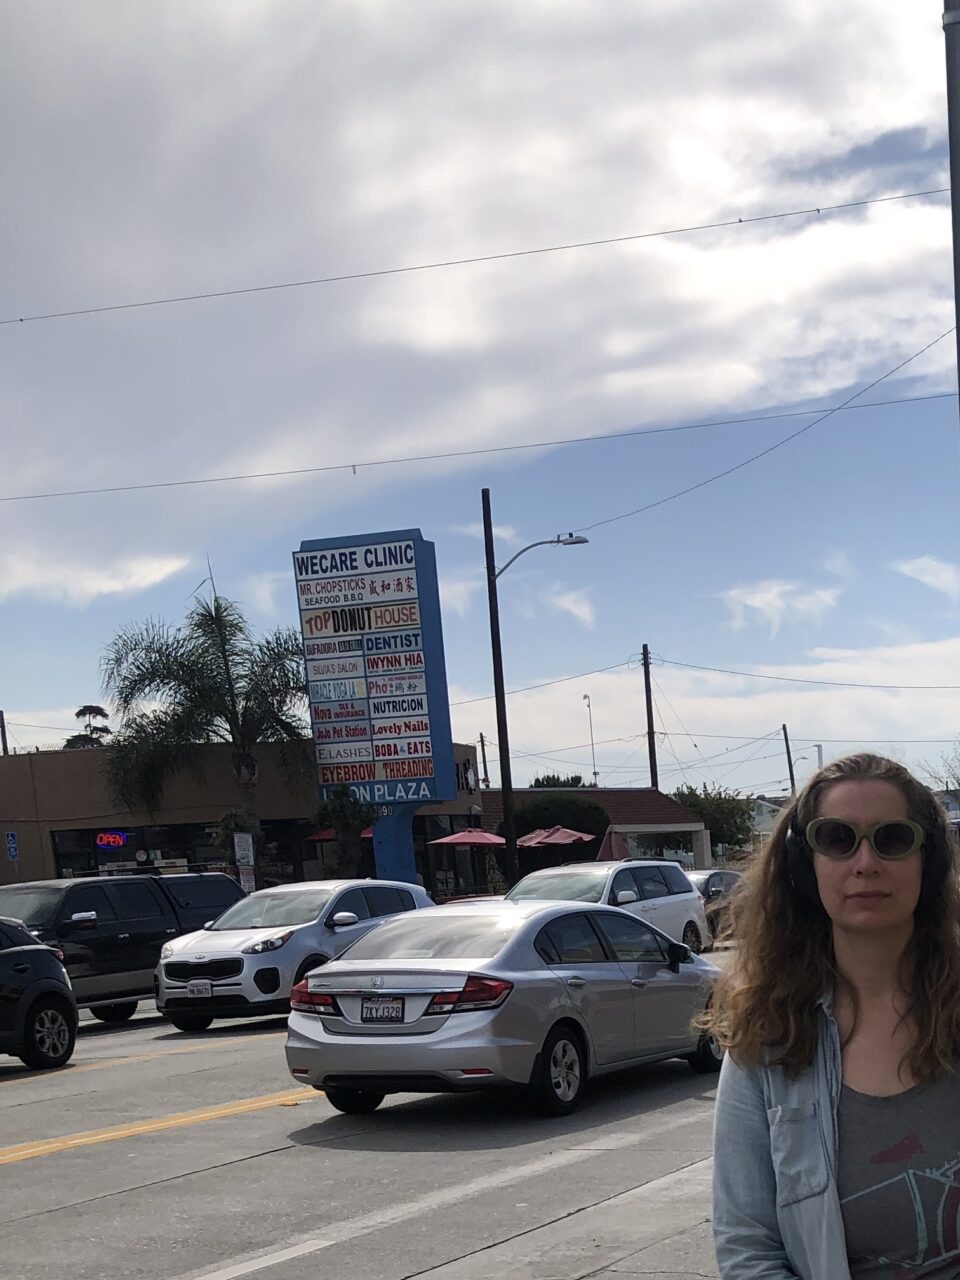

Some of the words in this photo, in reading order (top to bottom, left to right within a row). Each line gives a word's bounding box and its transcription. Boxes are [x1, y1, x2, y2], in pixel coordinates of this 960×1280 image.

[296, 551, 359, 576] WECARE
[364, 544, 414, 568] CLINIC
[305, 595, 341, 606] SEAFOOD
[305, 611, 332, 636] TOP
[332, 607, 373, 633] DONUT
[375, 606, 418, 625] HOUSE
[366, 634, 420, 651] DENTIST
[404, 653, 423, 666] HIA
[337, 662, 358, 673] SALON
[333, 680, 348, 699] YOGA
[314, 705, 332, 720] Nova
[373, 698, 424, 714] NUTRICION
[334, 709, 366, 719] INSURANCE
[333, 726, 344, 739] Pet
[345, 725, 367, 738] Station
[371, 723, 402, 736] Lovely
[404, 721, 429, 732] Nails
[375, 743, 399, 757] BOBA
[407, 741, 431, 755] EATS
[320, 763, 376, 783] EYEBROW
[382, 759, 433, 779] THREADING
[375, 782, 431, 801] PLAZA
[97, 833, 124, 847] OPEN
[364, 1006, 401, 1018] 7KYJ328
